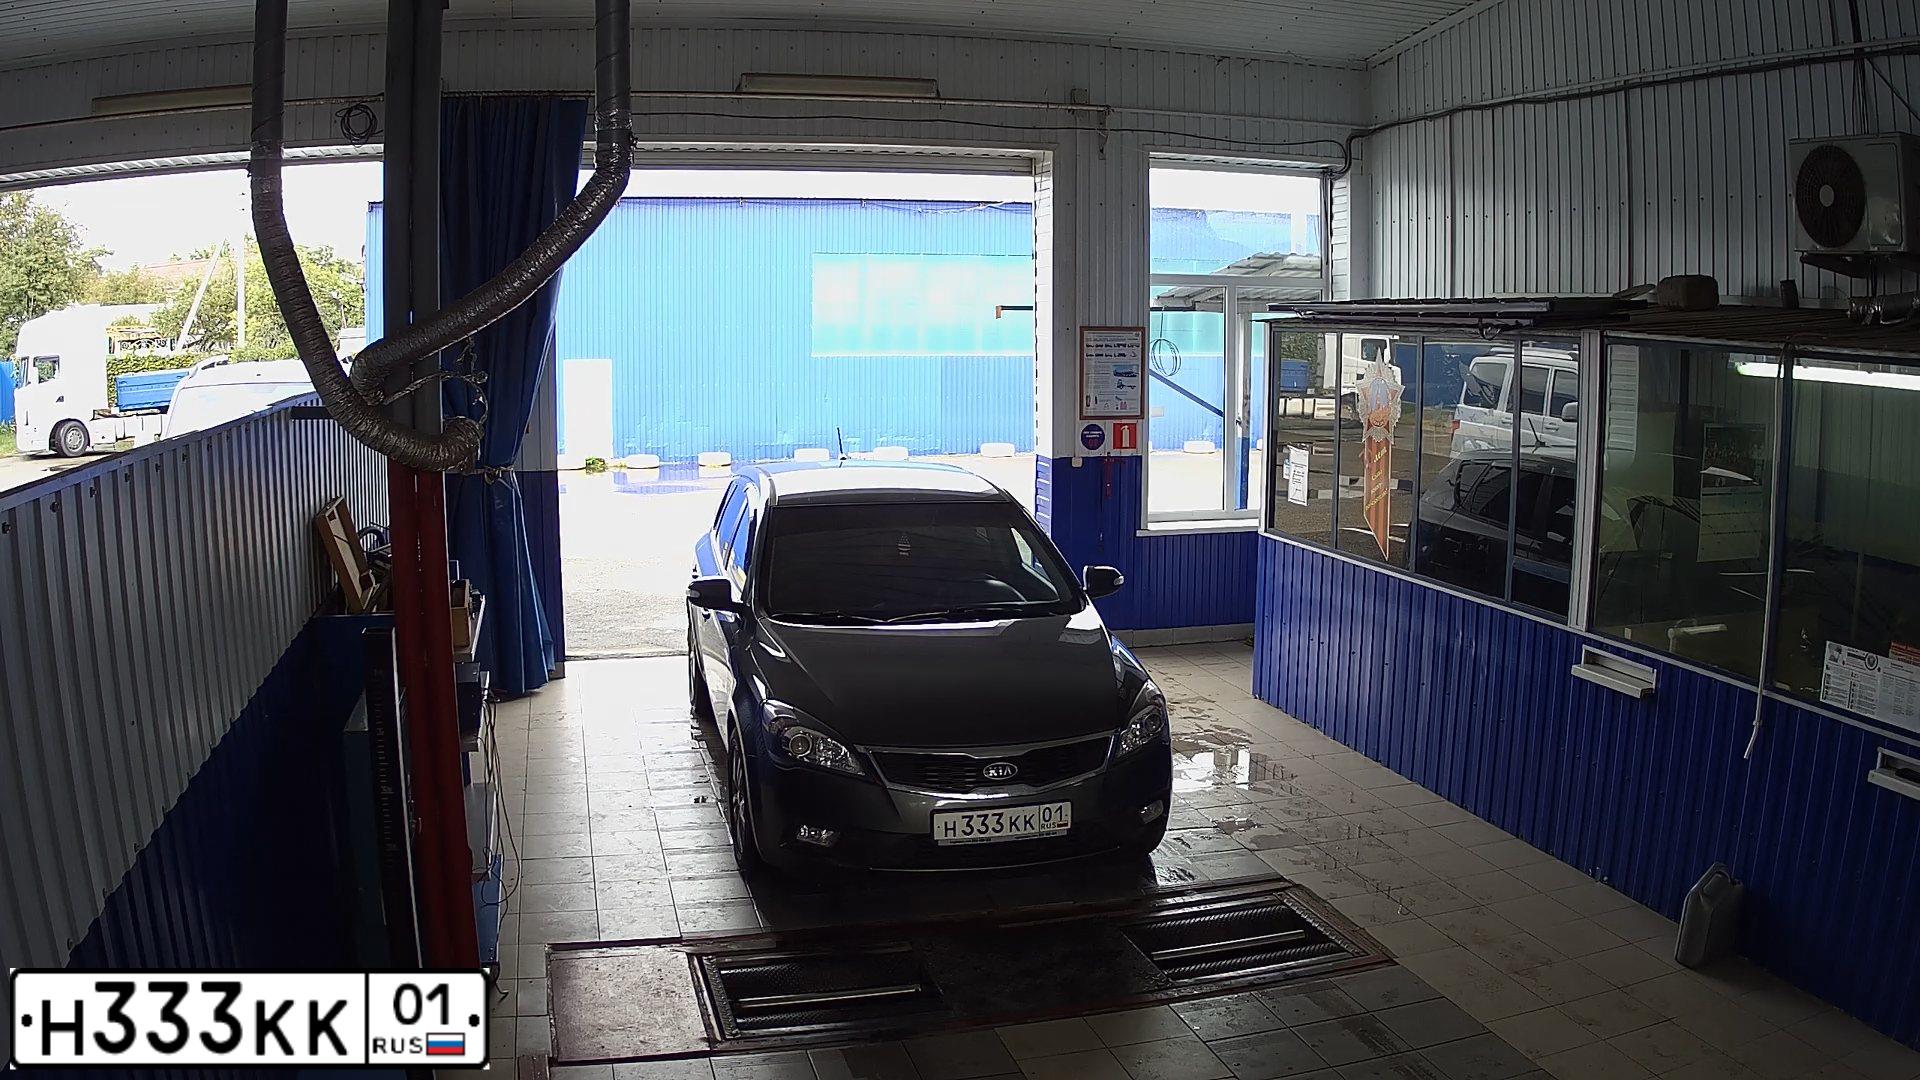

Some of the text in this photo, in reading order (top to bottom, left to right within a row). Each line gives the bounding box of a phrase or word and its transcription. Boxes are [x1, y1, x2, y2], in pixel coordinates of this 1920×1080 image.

[989, 766, 1012, 776] KIA
[944, 812, 1035, 838] Н333КК
[1042, 805, 1063, 823] 01
[1040, 822, 1057, 830] RUS
